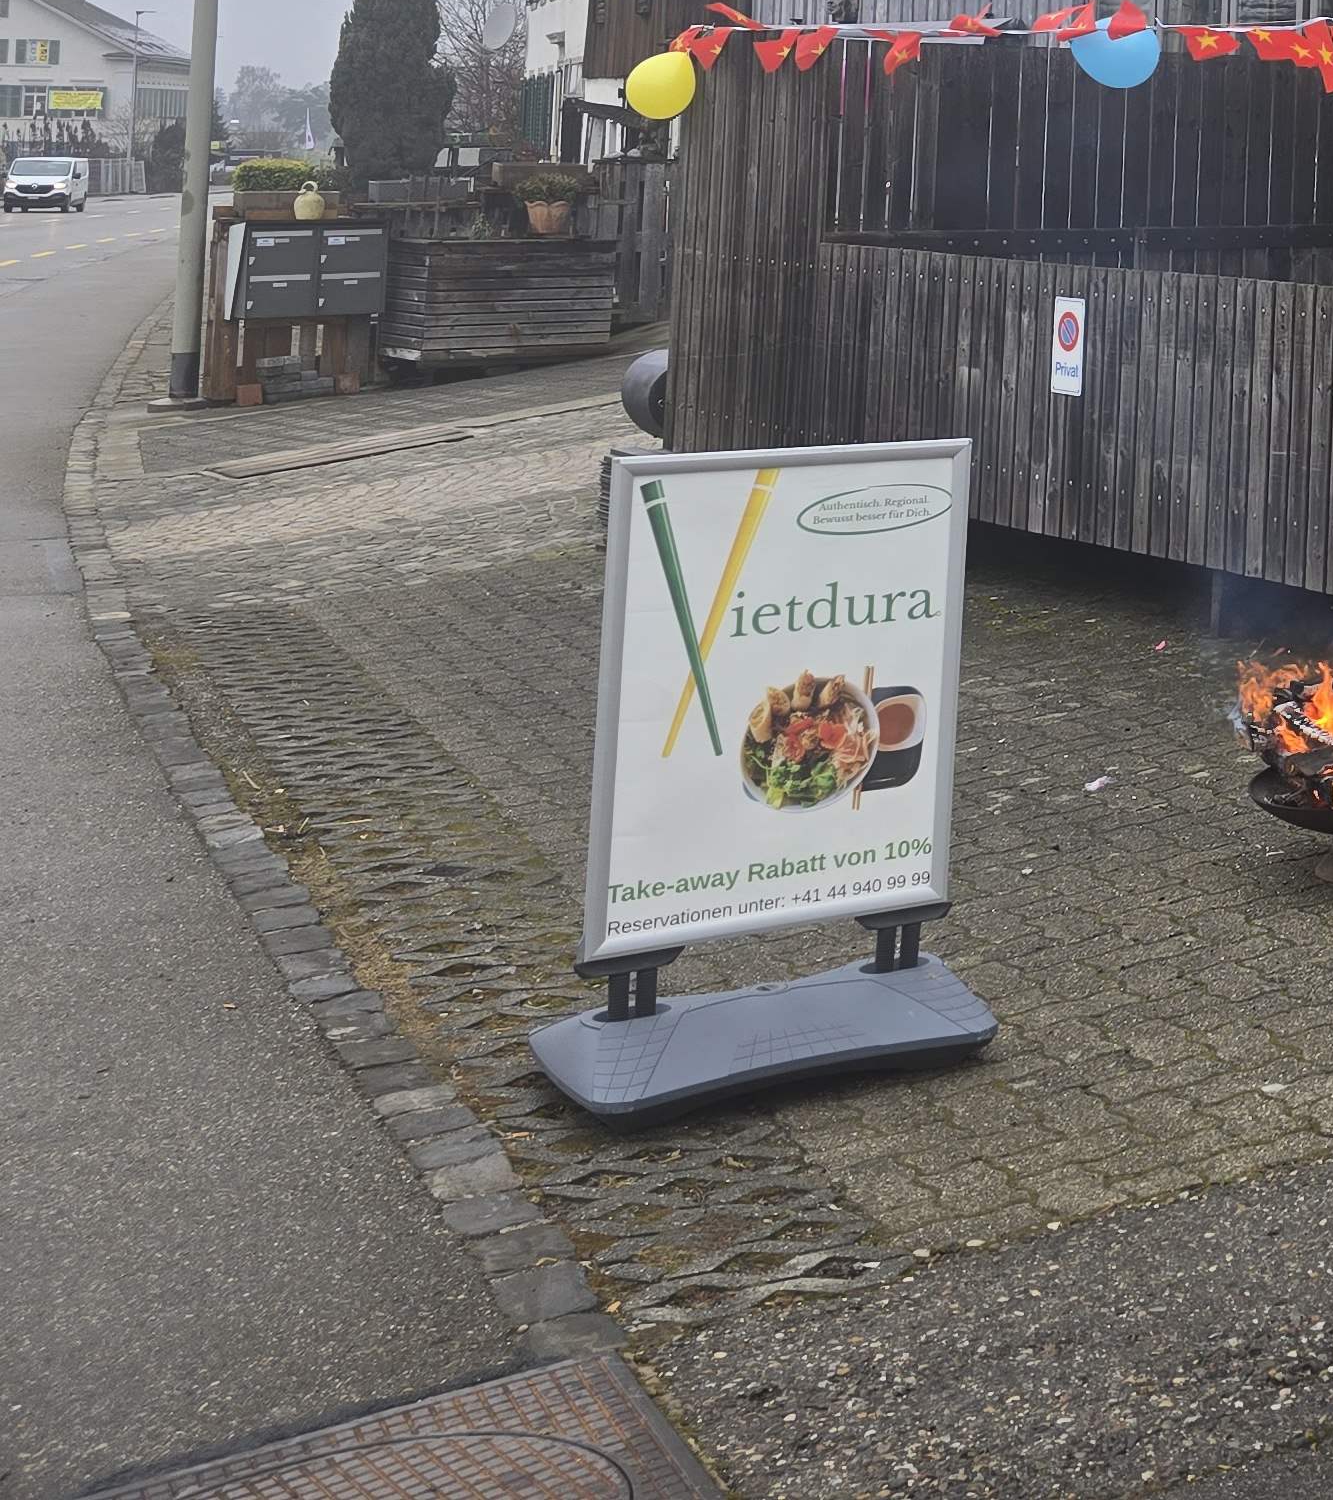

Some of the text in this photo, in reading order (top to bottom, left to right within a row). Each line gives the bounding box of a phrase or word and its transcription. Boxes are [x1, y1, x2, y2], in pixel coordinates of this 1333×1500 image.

[1055, 361, 1079, 378] Privat
[818, 495, 930, 512] Authentisch. Regional.
[812, 508, 932, 525] Bewusst besser für Dich.
[608, 836, 932, 904] Take-away Rabatt von 10%
[607, 870, 931, 937] Reservationen unter: +41 44 940 99 99
